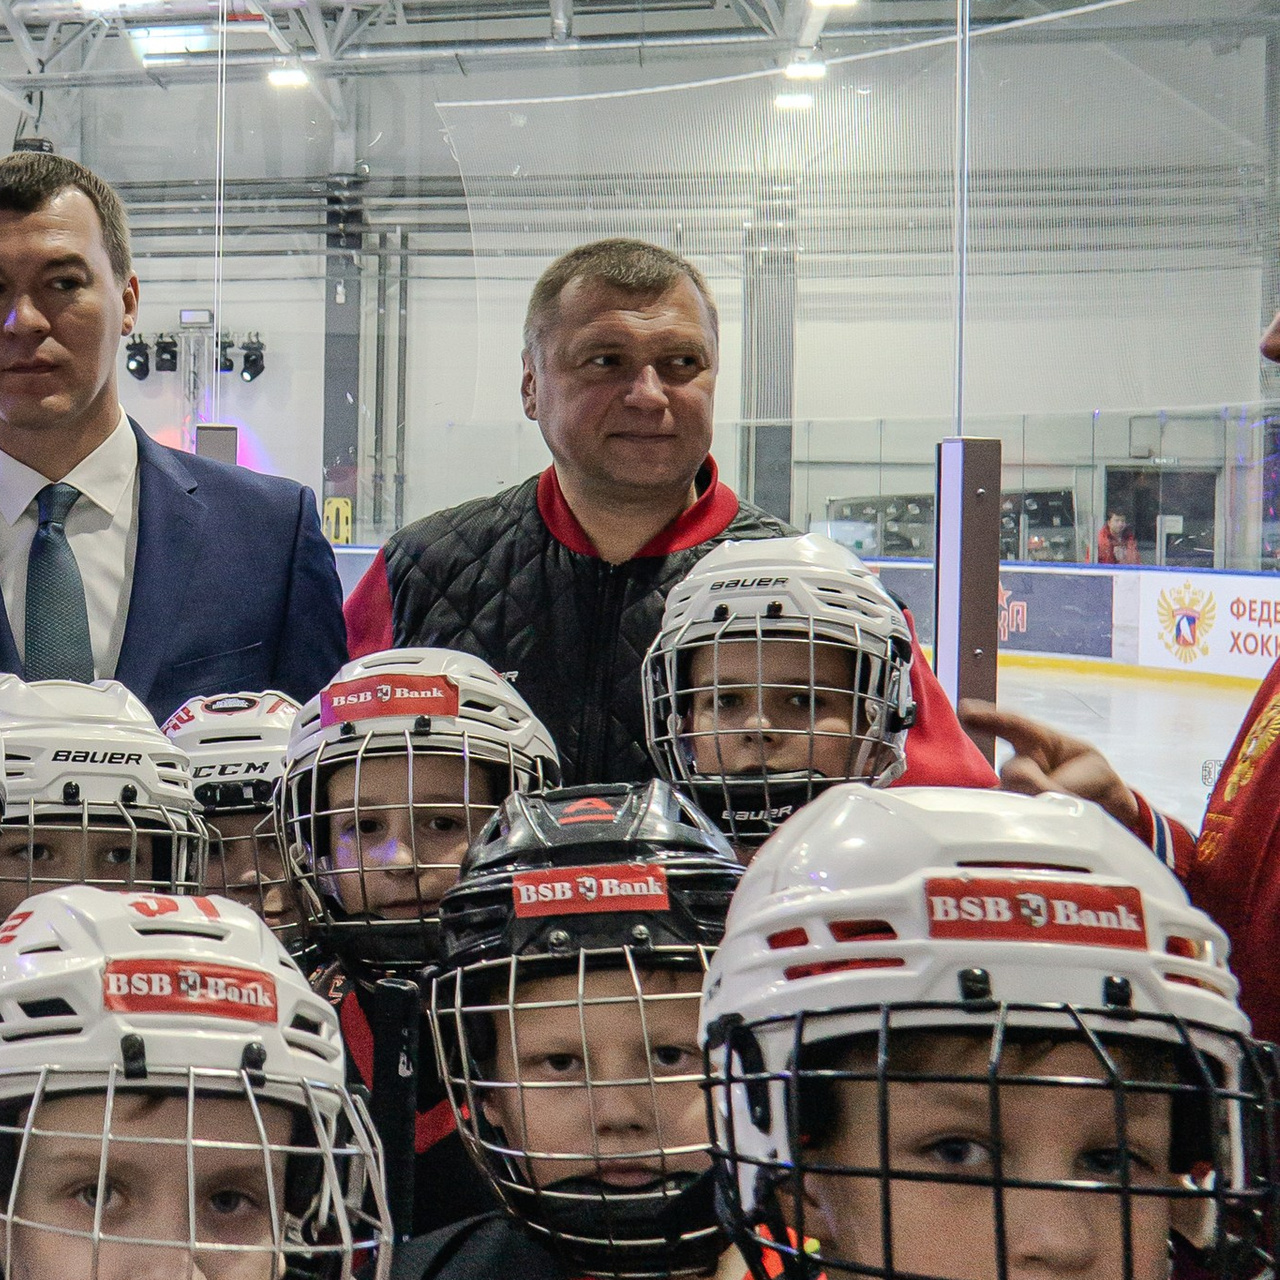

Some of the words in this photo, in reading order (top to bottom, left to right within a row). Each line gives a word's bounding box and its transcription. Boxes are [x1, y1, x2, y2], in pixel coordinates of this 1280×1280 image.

[710, 577, 789, 591] BAUER
[332, 690, 372, 707] BSB
[394, 687, 444, 698] Bank
[51, 750, 142, 765] BAUER
[192, 761, 270, 779] CCM
[518, 882, 573, 904] BSB
[599, 876, 664, 897] Bank
[929, 896, 1013, 922] BSB
[1050, 900, 1142, 931] Bank
[105, 972, 172, 996] BSB
[205, 976, 275, 1008] Bank
